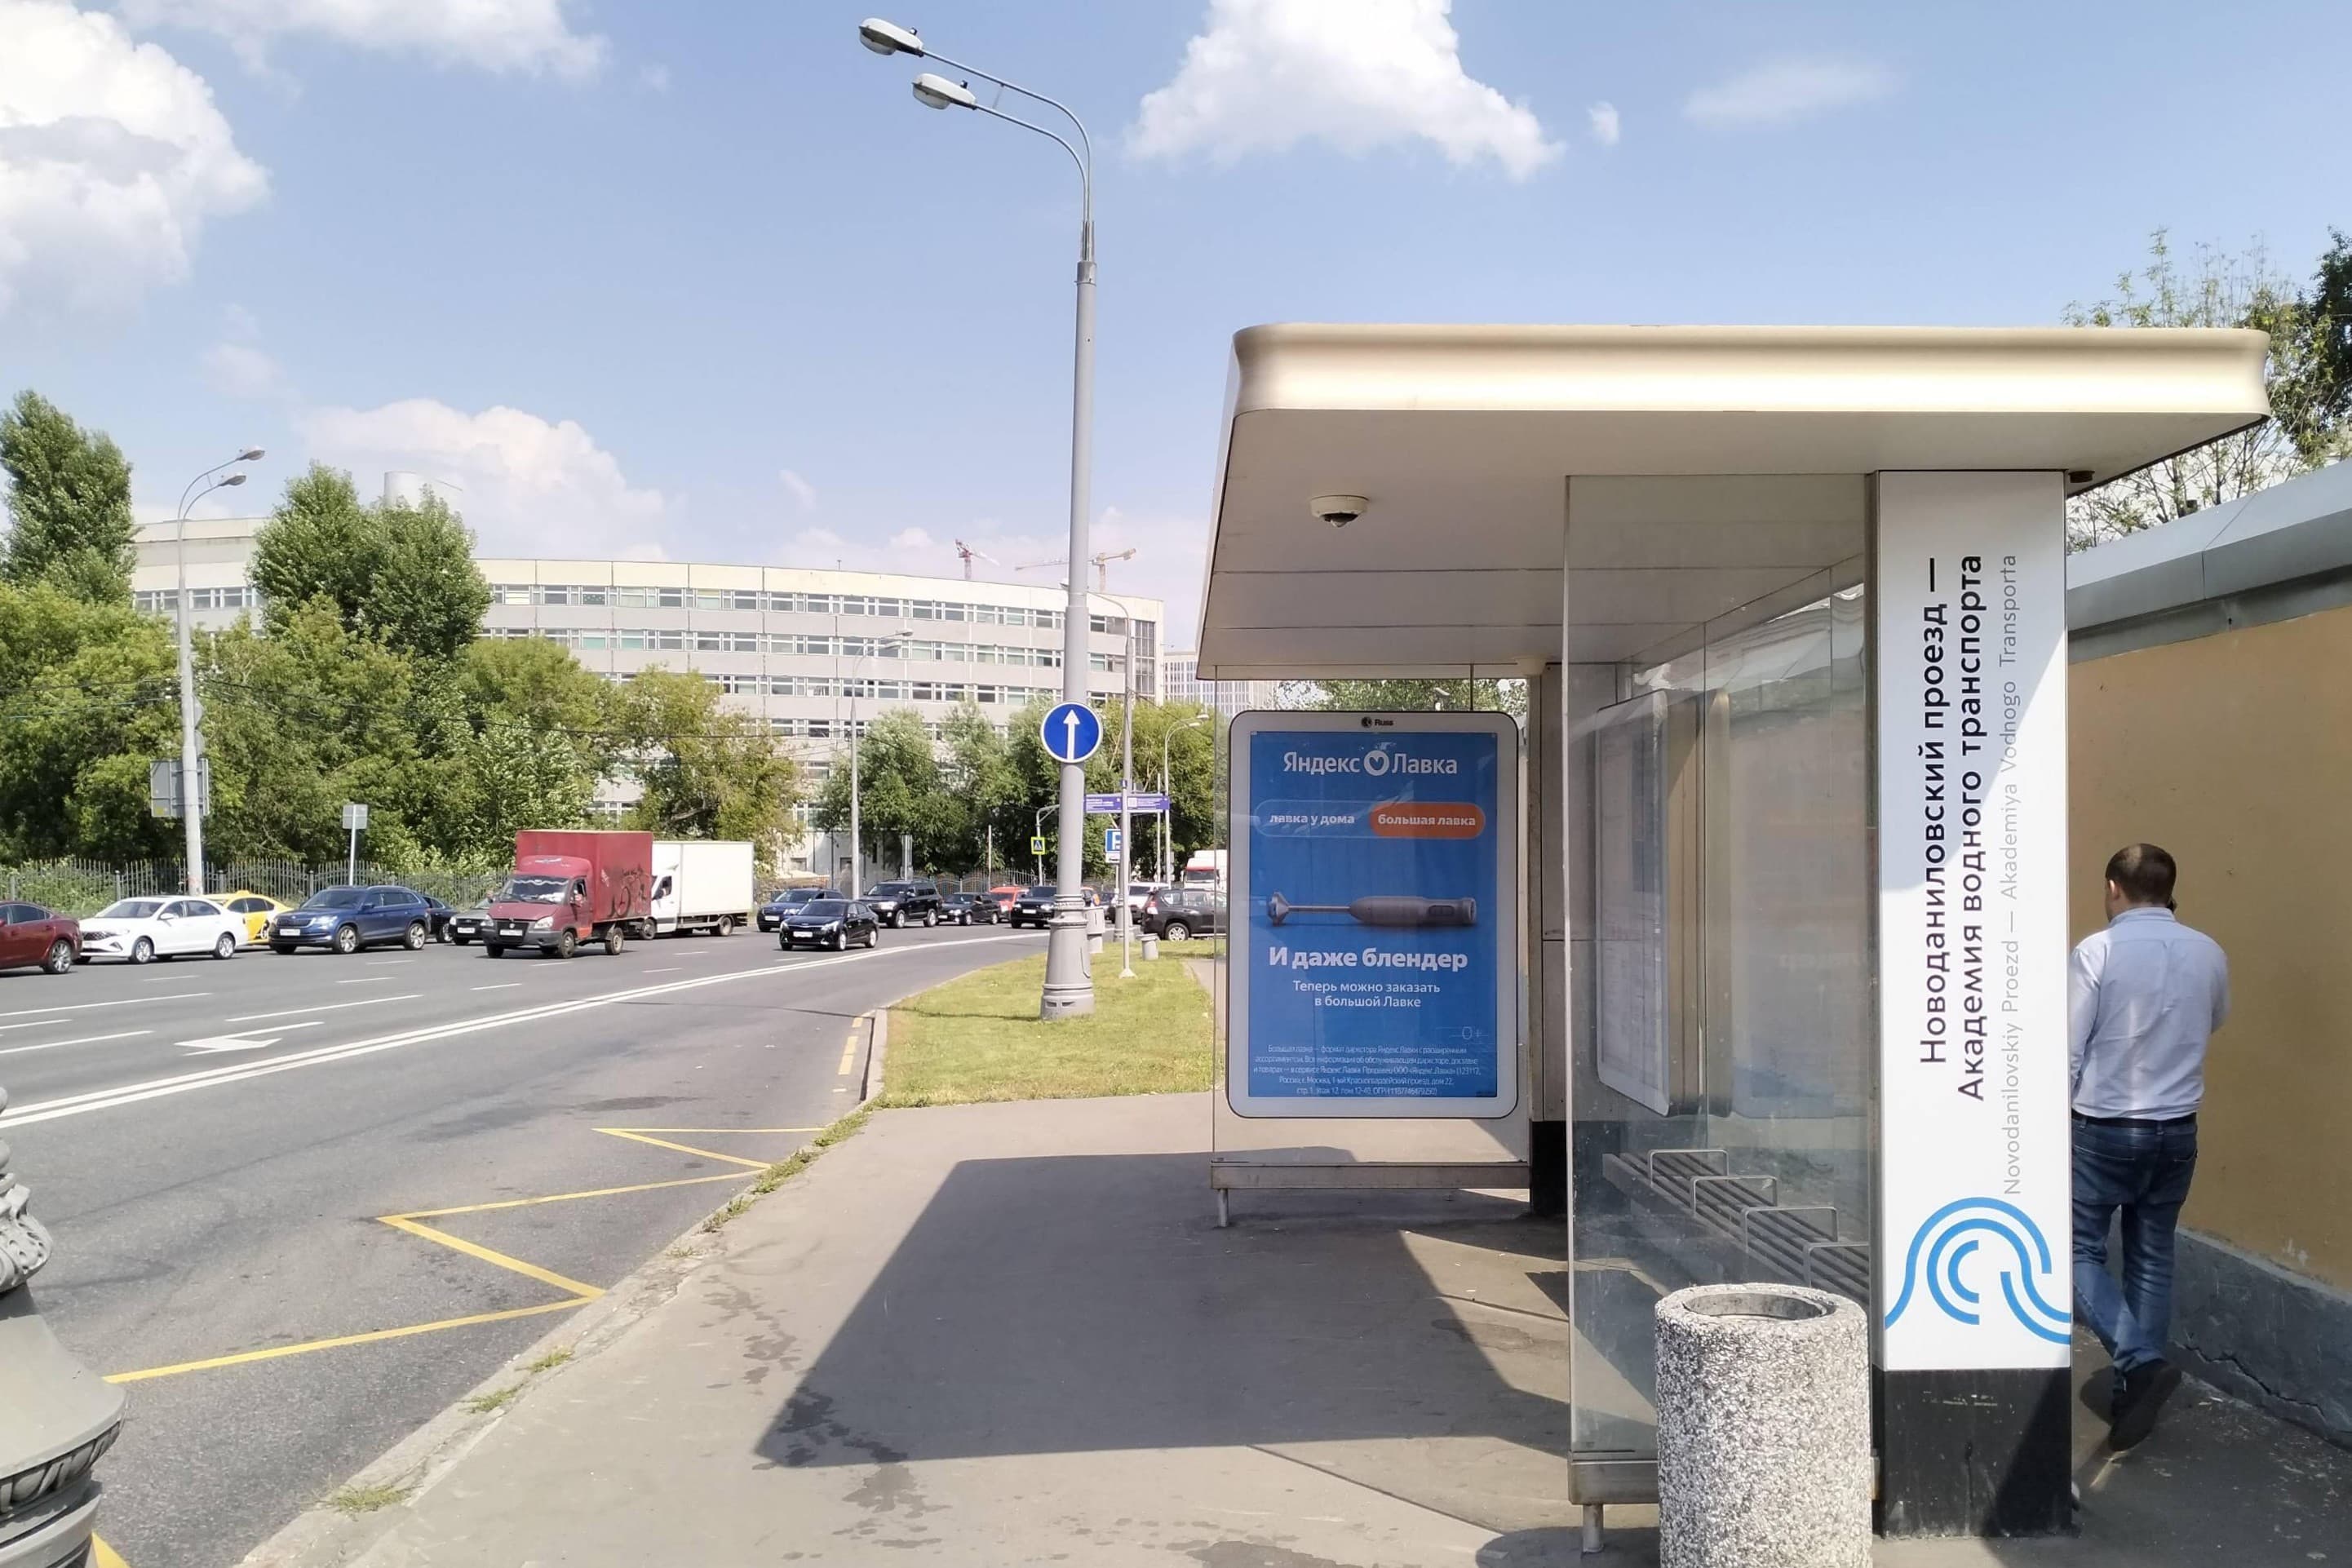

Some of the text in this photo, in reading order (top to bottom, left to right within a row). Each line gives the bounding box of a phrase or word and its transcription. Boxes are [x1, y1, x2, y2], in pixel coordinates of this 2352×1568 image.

[1998, 555, 2021, 668] Transporta
[1924, 603, 1951, 729] проезд
[1283, 751, 1458, 775] Яндекс Лавка
[1999, 680, 2021, 773] Vodnogo
[1269, 814, 1355, 826] лавка у дома
[1377, 813, 1476, 826] большая лавка
[1957, 555, 1988, 1101] Академия водного транспорта
[1999, 782, 2022, 901] Akademiya
[1917, 742, 1951, 1064] Новоданиловский
[1269, 946, 1468, 972] И даже блендер
[1292, 980, 1441, 994] Теперь можно заказать
[2000, 940, 2020, 1012] Proezd
[1314, 994, 1422, 1008] в большой Лавке
[2001, 1021, 2023, 1195] Novodanilovskiy
